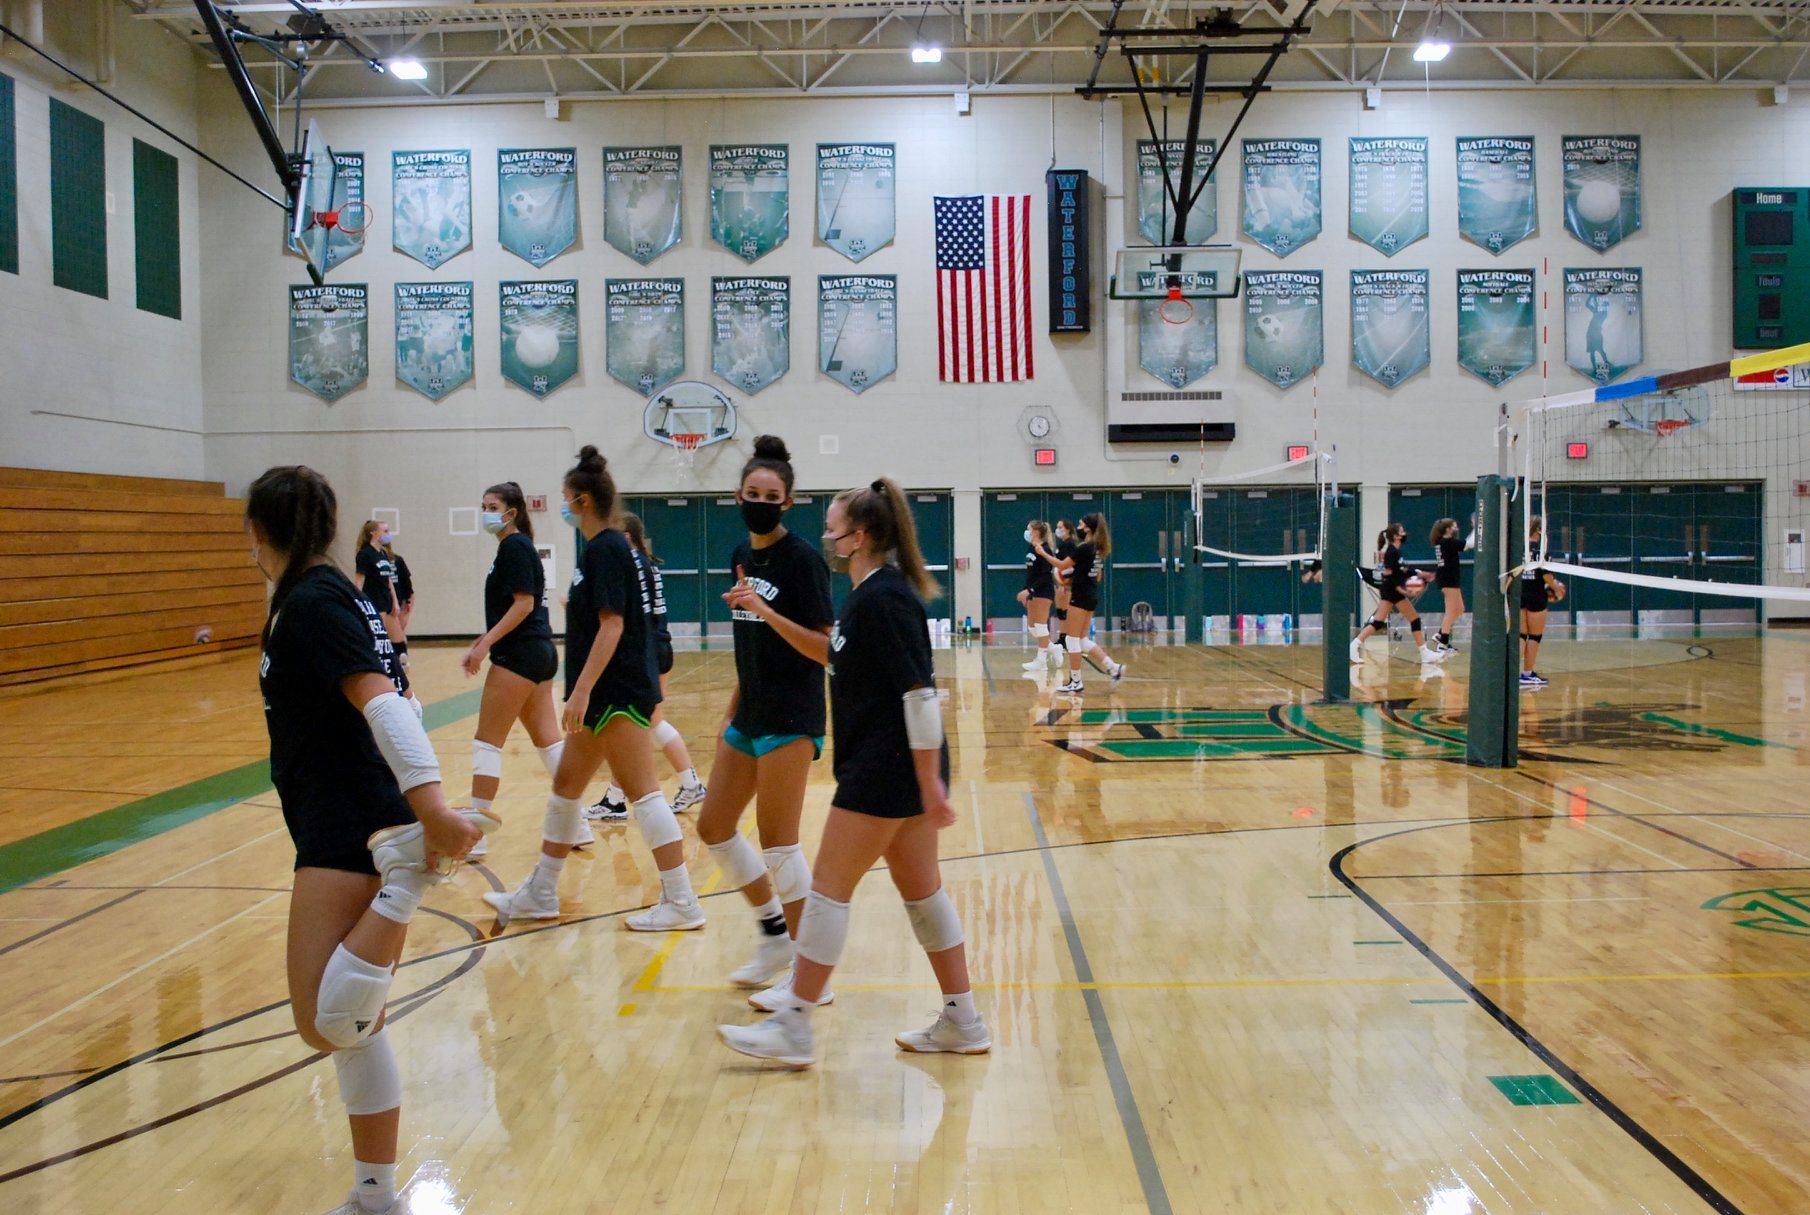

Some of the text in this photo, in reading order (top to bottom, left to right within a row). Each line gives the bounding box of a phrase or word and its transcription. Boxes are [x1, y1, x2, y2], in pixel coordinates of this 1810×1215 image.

[1246, 141, 1318, 153] WATERFORD
[1352, 140, 1425, 151] WATERFORD
[1459, 139, 1531, 150] WATERFORD
[1565, 139, 1637, 150] WATERFORD
[501, 151, 572, 162] WATERFORD
[607, 150, 678, 161] WATERFORD
[713, 148, 785, 159] WATERFORD
[820, 146, 893, 157] WATERFORD
[395, 153, 467, 164] WATERFORD
[1756, 192, 1783, 204] Home
[1057, 174, 1079, 325] WATERFORD
[1248, 273, 1320, 285] WATERFORD
[1354, 272, 1426, 284] WATERFORD
[1460, 272, 1532, 283] WATERFORD
[1567, 271, 1639, 282] WATERFORD
[503, 283, 575, 295] WATERFORD
[609, 281, 681, 293] WATERFORD
[715, 278, 787, 290] WATERFORD
[822, 278, 894, 289] WATERFORD
[293, 287, 365, 298] WATERFORD
[399, 285, 469, 296] WATERFORD
